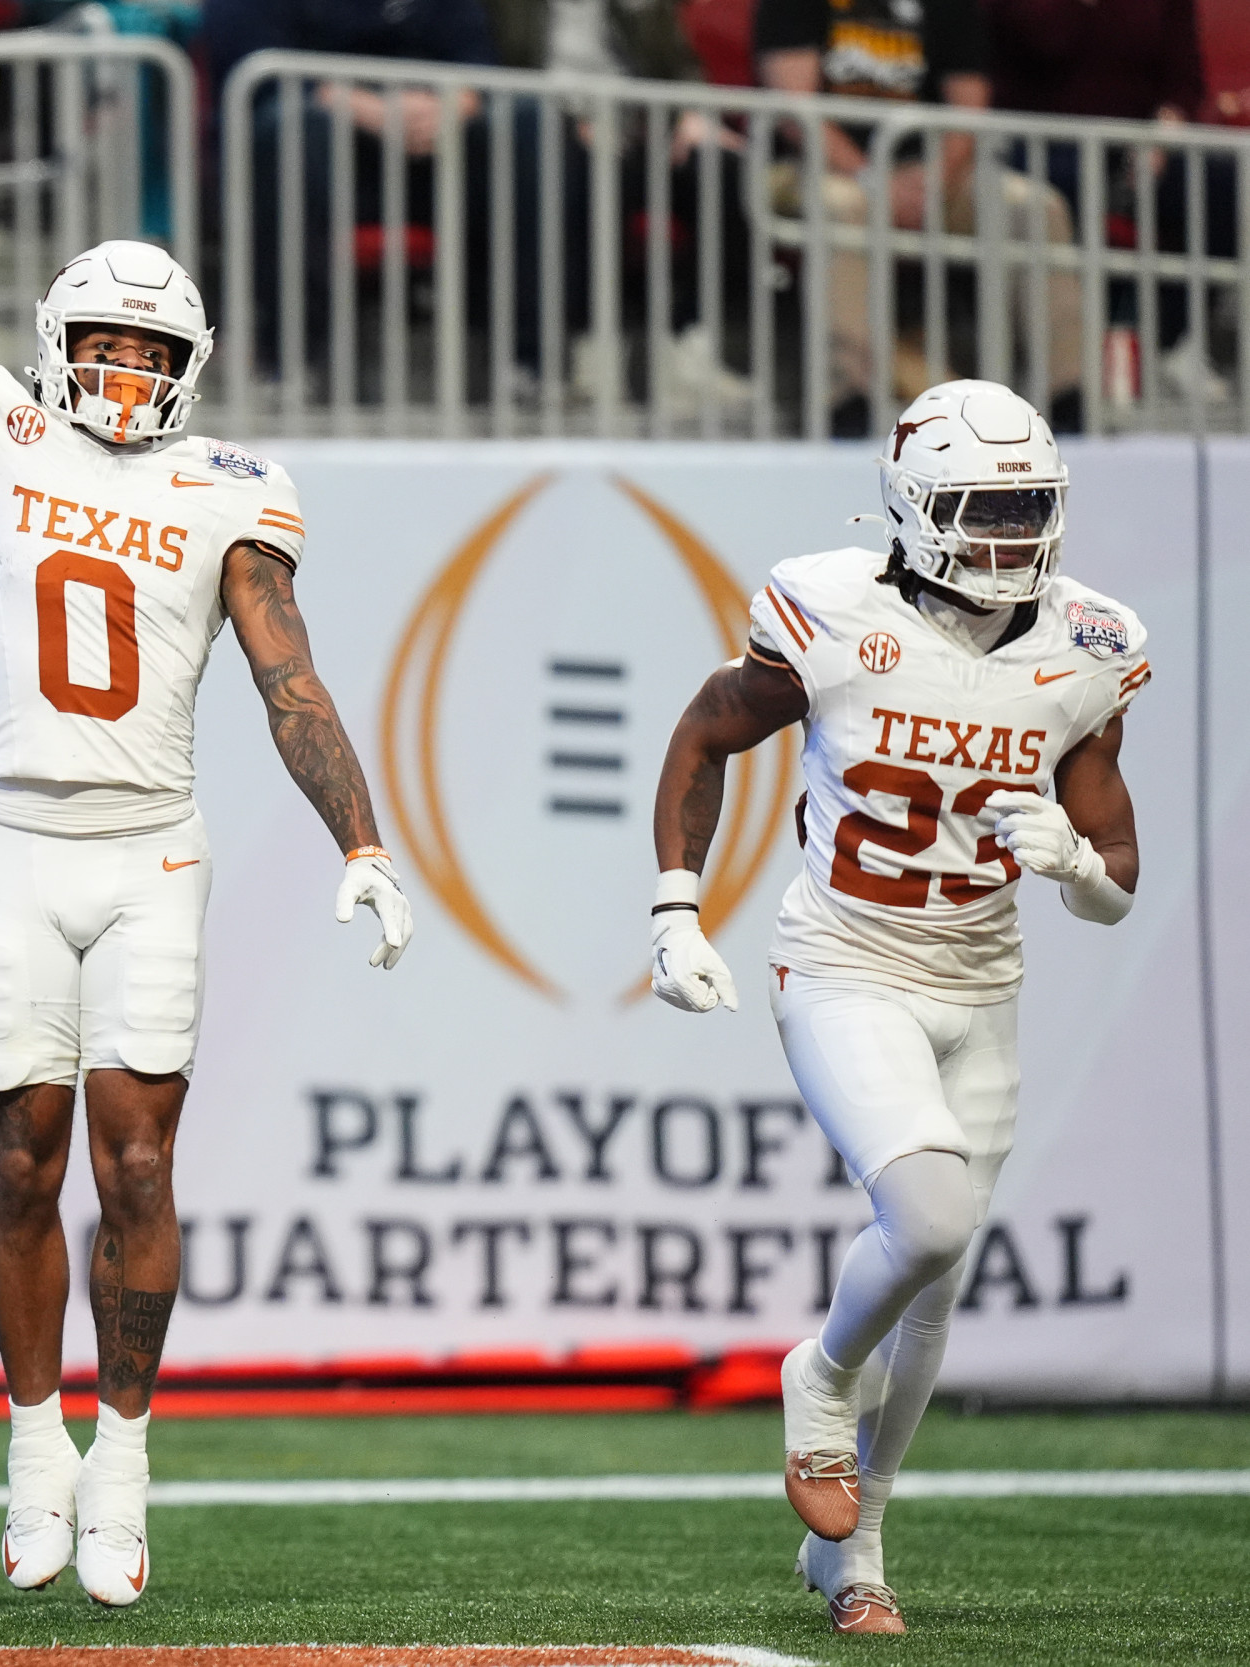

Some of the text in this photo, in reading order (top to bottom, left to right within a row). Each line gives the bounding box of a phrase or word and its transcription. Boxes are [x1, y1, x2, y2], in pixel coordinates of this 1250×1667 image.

[122, 298, 157, 312] HORNS
[8, 406, 46, 444] SEC
[209, 448, 268, 474] PEACH
[997, 462, 1032, 472] HORNS
[12, 484, 188, 572] TEXAS
[35, 549, 140, 722] 0
[859, 633, 901, 674] SEC
[1070, 623, 1128, 648] PEACH
[1082, 637, 1117, 649] BOWL
[872, 708, 1046, 775] TEXAS
[830, 760, 1040, 909] 23
[307, 1092, 848, 1190] PLAYOF
[83, 1214, 1130, 1312] UARTERFIAL
